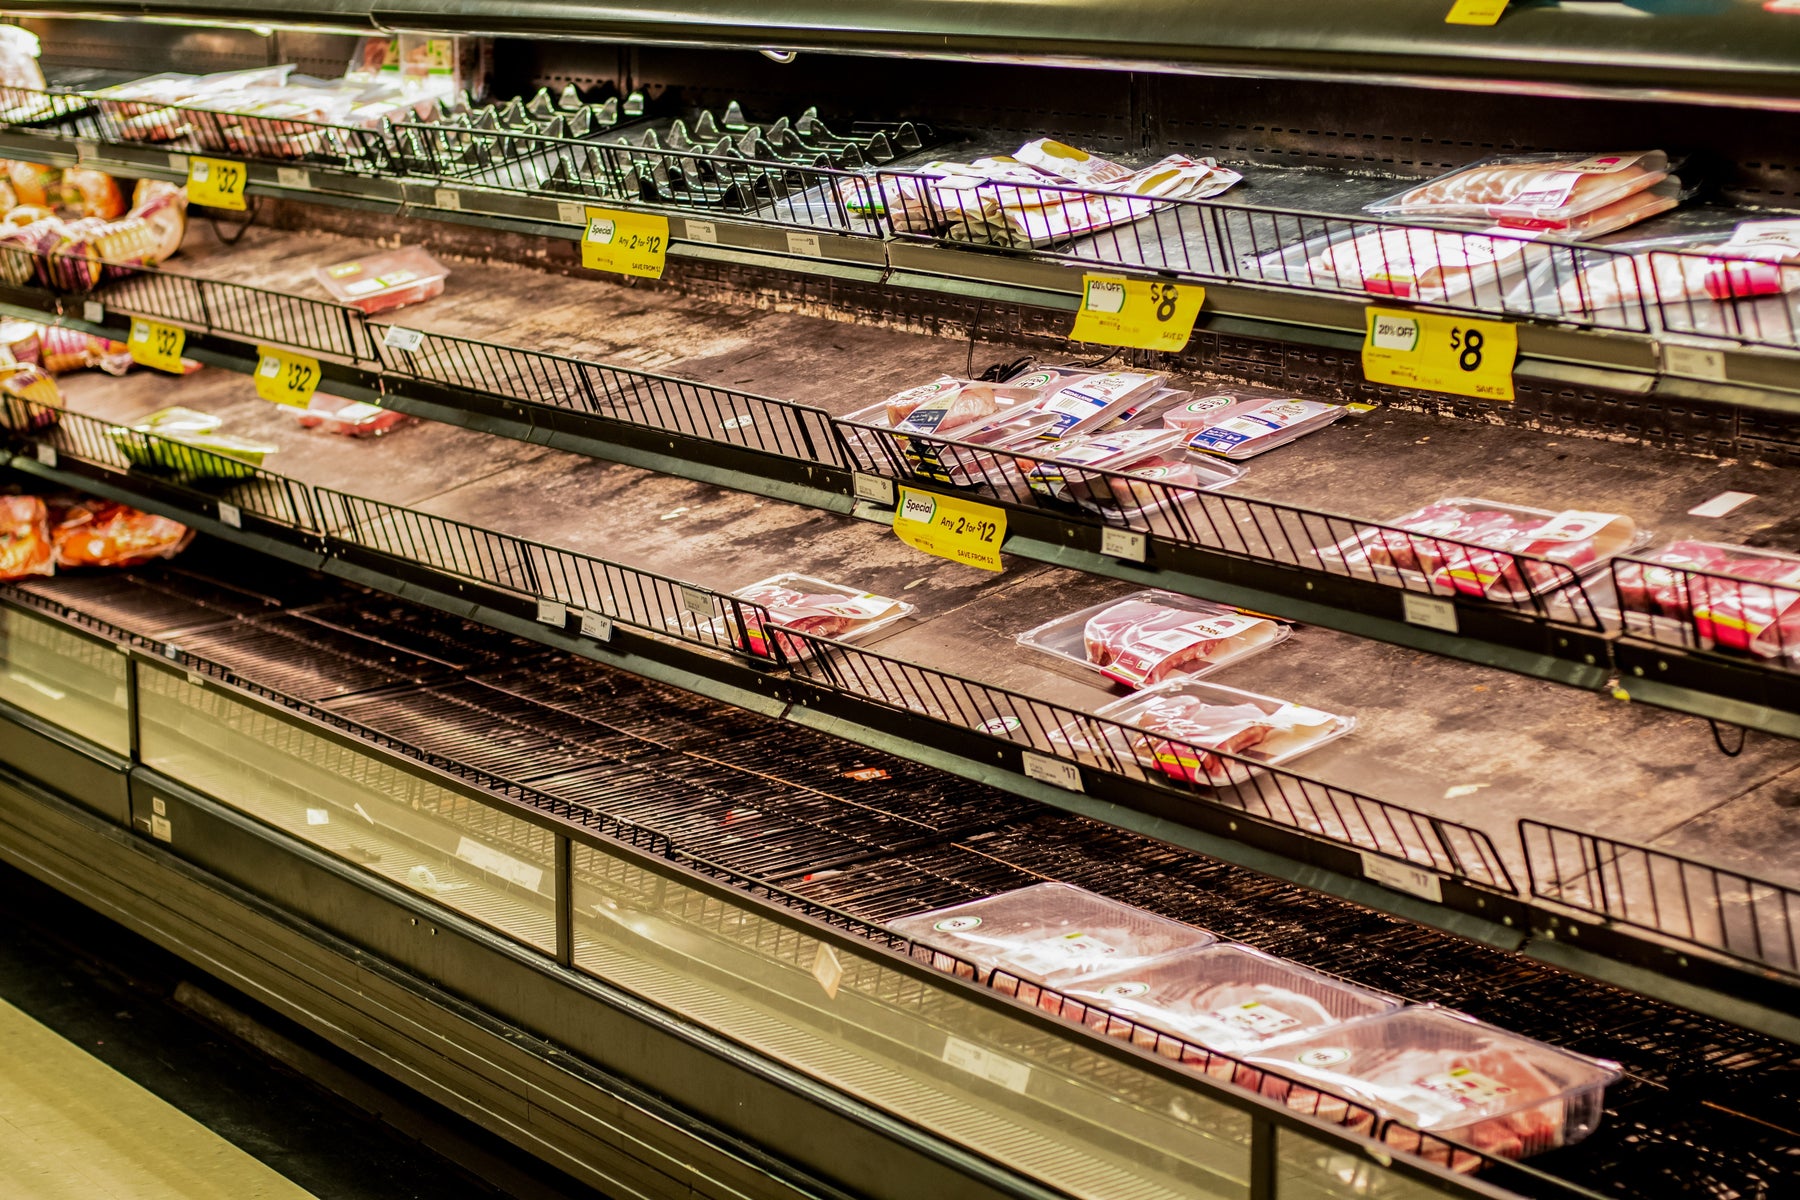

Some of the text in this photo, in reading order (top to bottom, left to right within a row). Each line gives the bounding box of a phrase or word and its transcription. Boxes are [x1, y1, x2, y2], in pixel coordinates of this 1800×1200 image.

[591, 224, 613, 235] Special
[619, 234, 661, 253] Any 2 for $12
[632, 262, 643, 271] SAVE
[642, 264, 656, 272] FROM
[1091, 280, 1121, 292] 20% OFF
[1150, 283, 1179, 322] $8
[1378, 324, 1415, 338] 20% OFF
[1450, 326, 1484, 372] $8
[287, 362, 313, 393] $32
[906, 499, 933, 514] Special
[940, 517, 997, 543] Any 2 for $12
[957, 549, 994, 565] SAVE FROM $2
